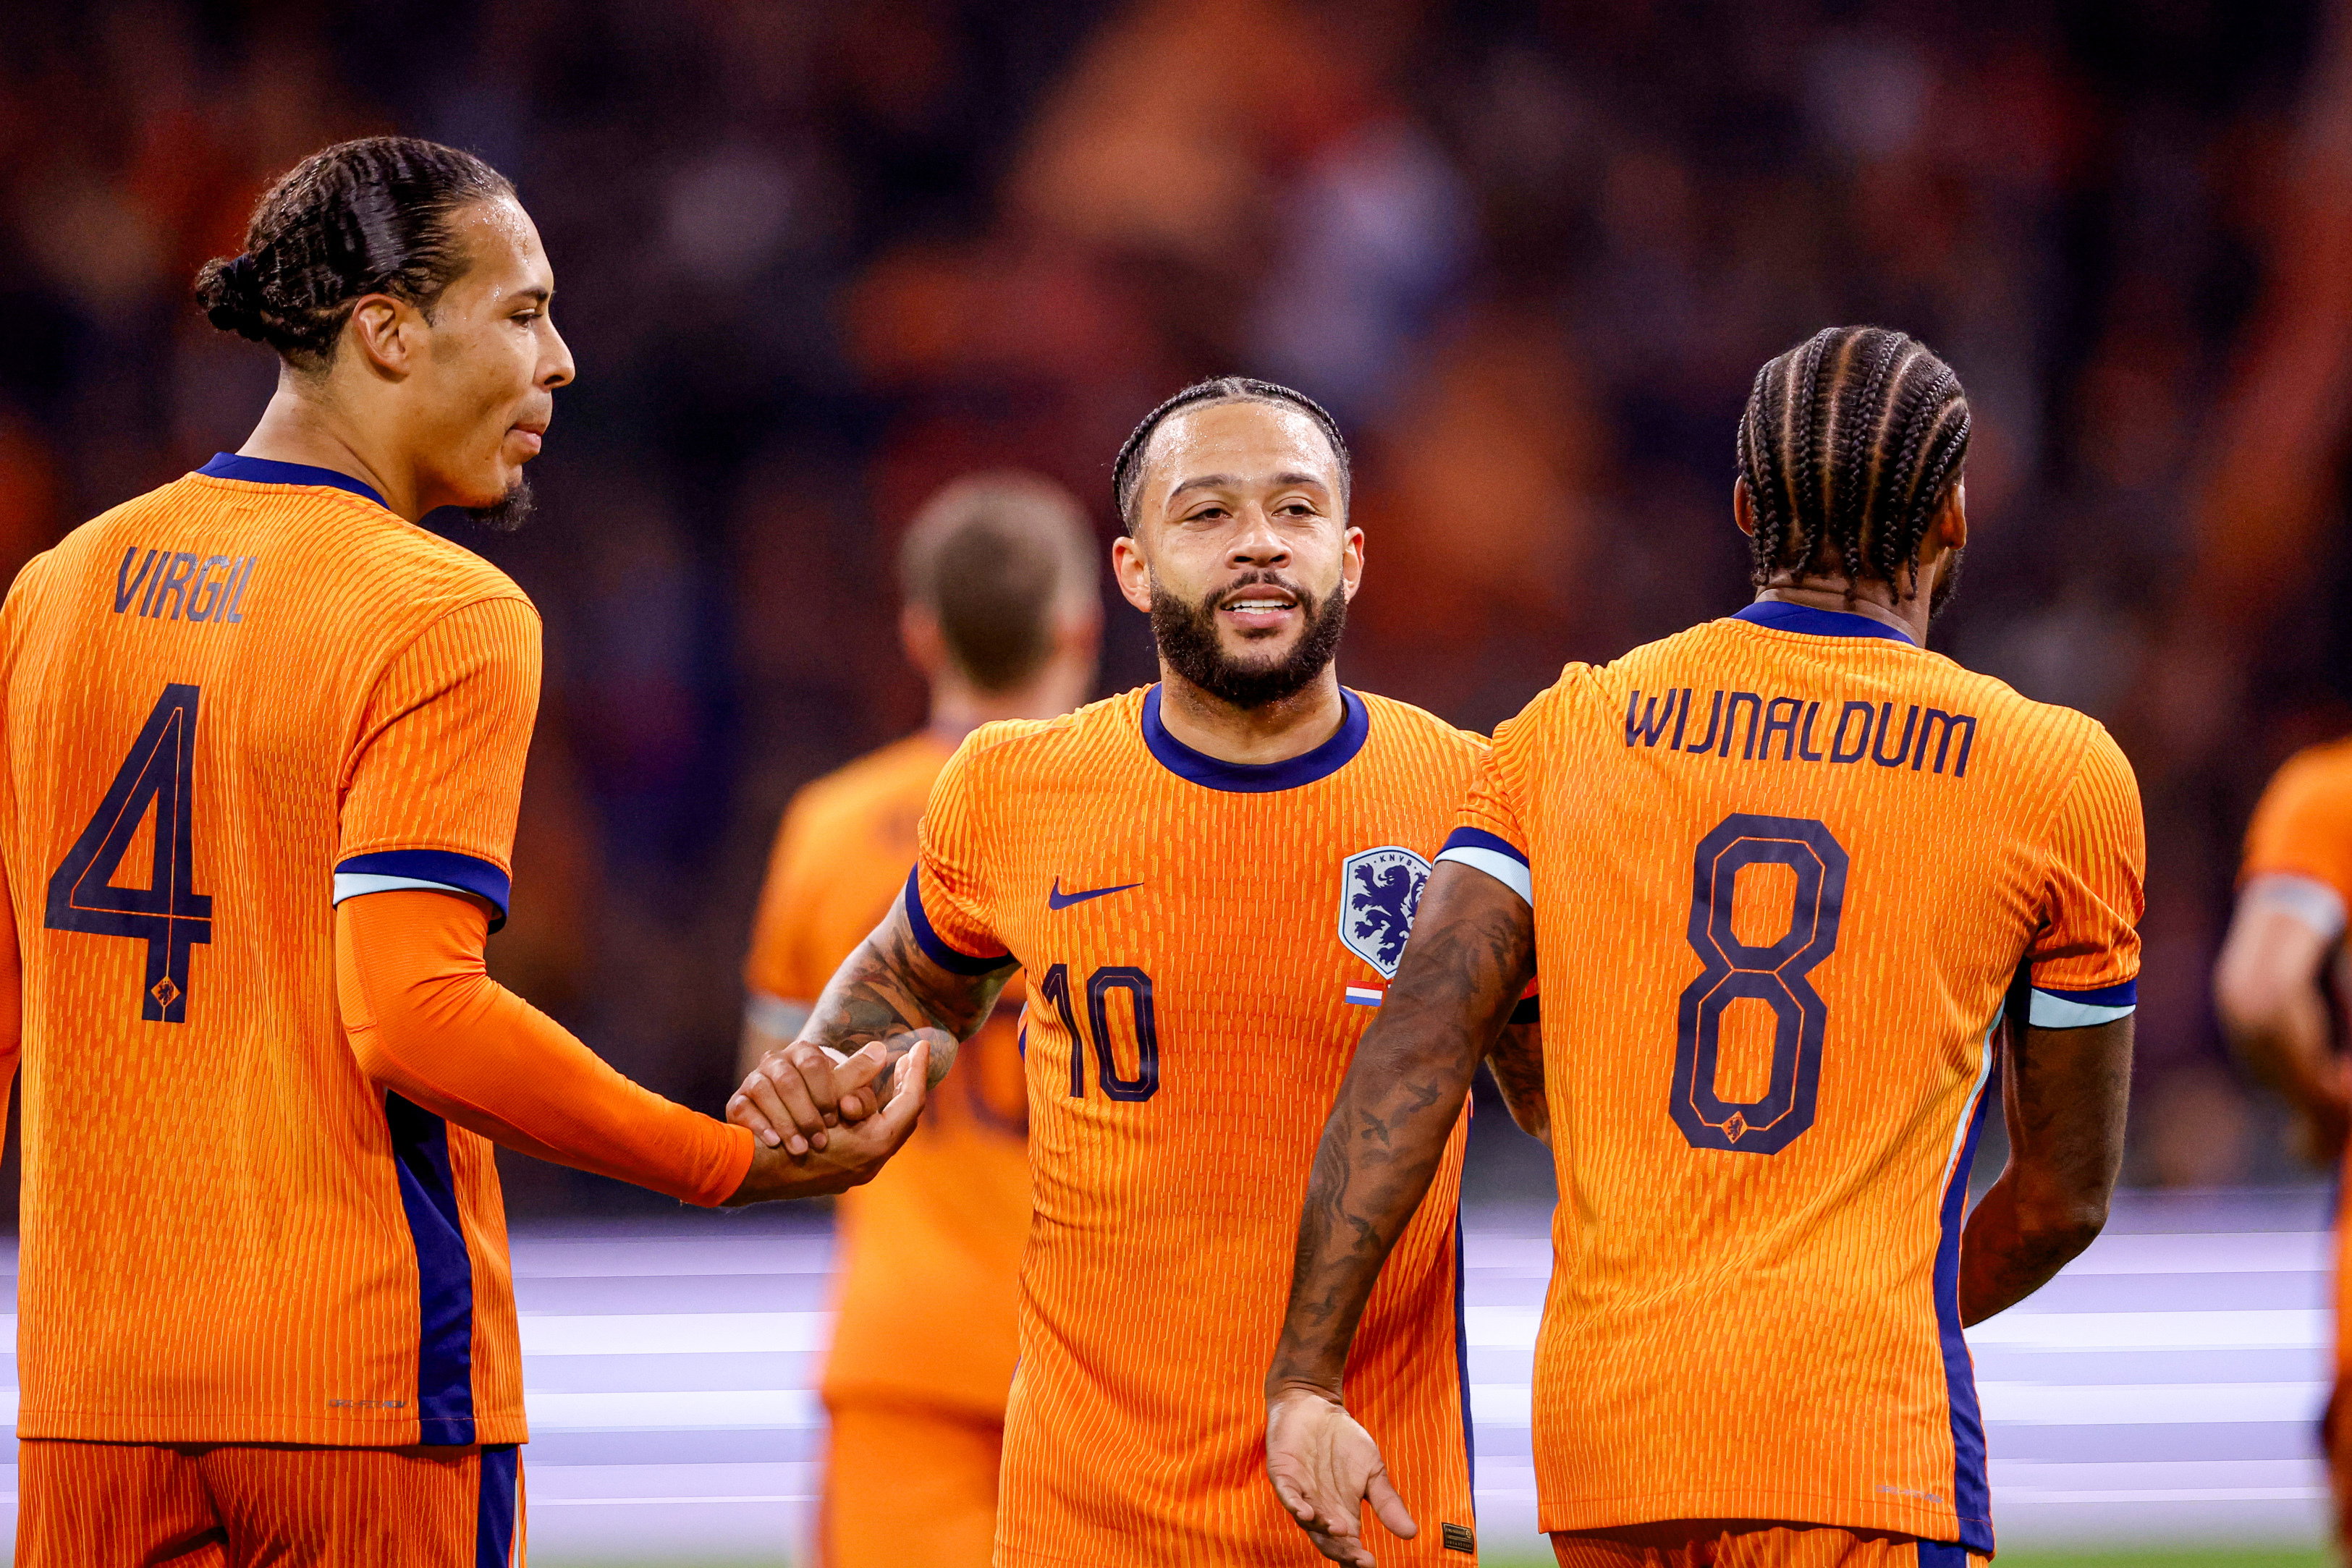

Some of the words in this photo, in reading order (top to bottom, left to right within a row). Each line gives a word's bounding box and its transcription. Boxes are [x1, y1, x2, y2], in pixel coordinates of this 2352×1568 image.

[113, 546, 257, 623] VIRGIL
[1625, 688, 1976, 778] WIJNALDUM
[44, 683, 212, 1023] 4
[1379, 854, 1412, 866] KNVB
[1041, 963, 1159, 1102] 10
[1668, 812, 1850, 1156] 8
